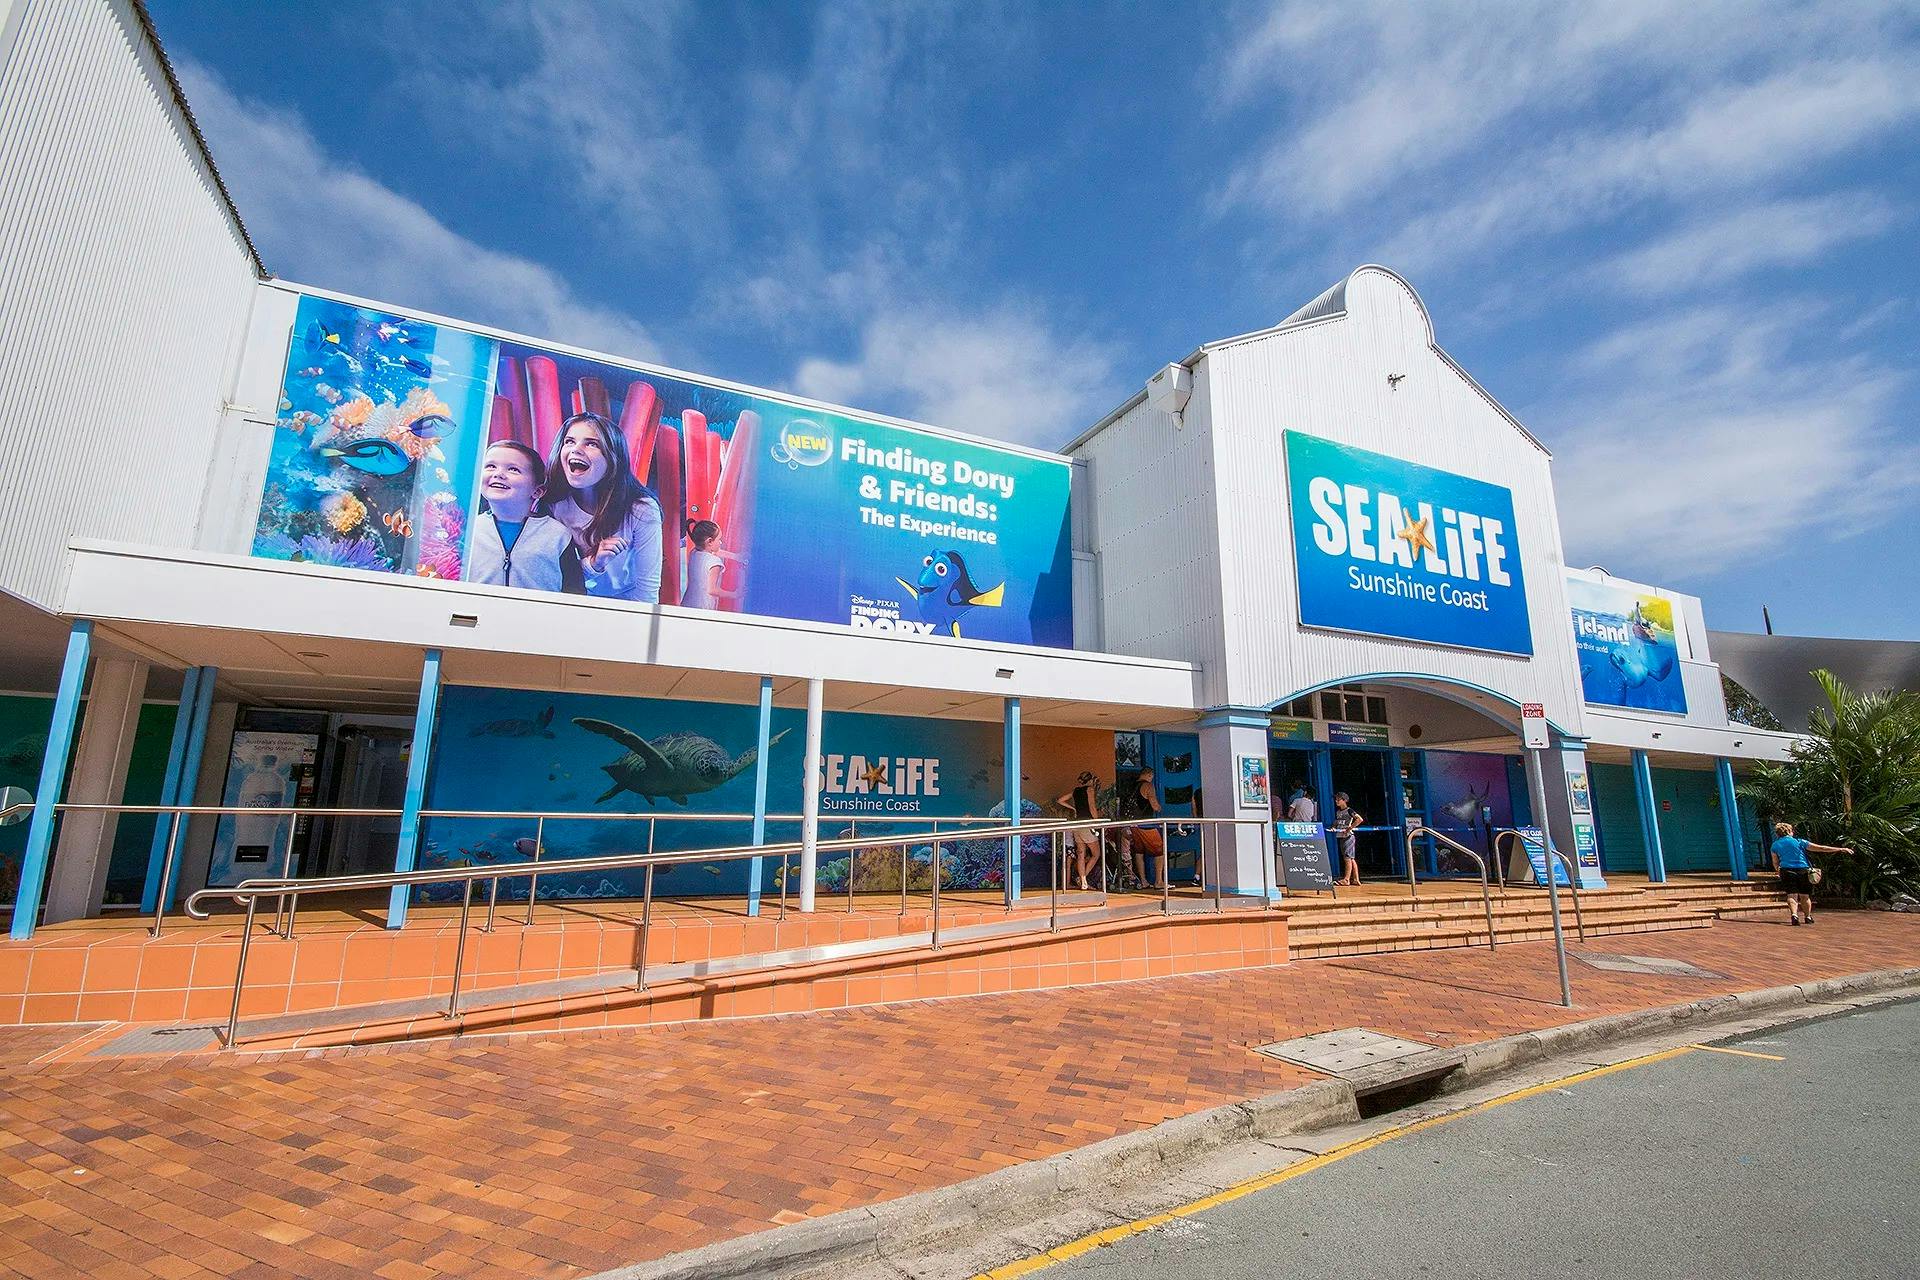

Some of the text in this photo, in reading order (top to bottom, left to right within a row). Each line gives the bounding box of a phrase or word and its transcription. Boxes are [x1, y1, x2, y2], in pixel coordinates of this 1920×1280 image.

[787, 433, 828, 451] NEW
[841, 437, 1015, 499] Finding Dory
[859, 475, 997, 522] & Friends:
[859, 506, 997, 545] The Experience
[1309, 476, 1413, 569] SEA
[1348, 566, 1489, 611] Sunshine Coast
[851, 605, 900, 620] FINDING
[877, 600, 900, 609] PIXAR
[1577, 615, 1630, 643] Island
[1522, 703, 1543, 711] LOADING
[823, 797, 921, 811] Sunshine Coast
[1283, 824, 1301, 834] SEA
